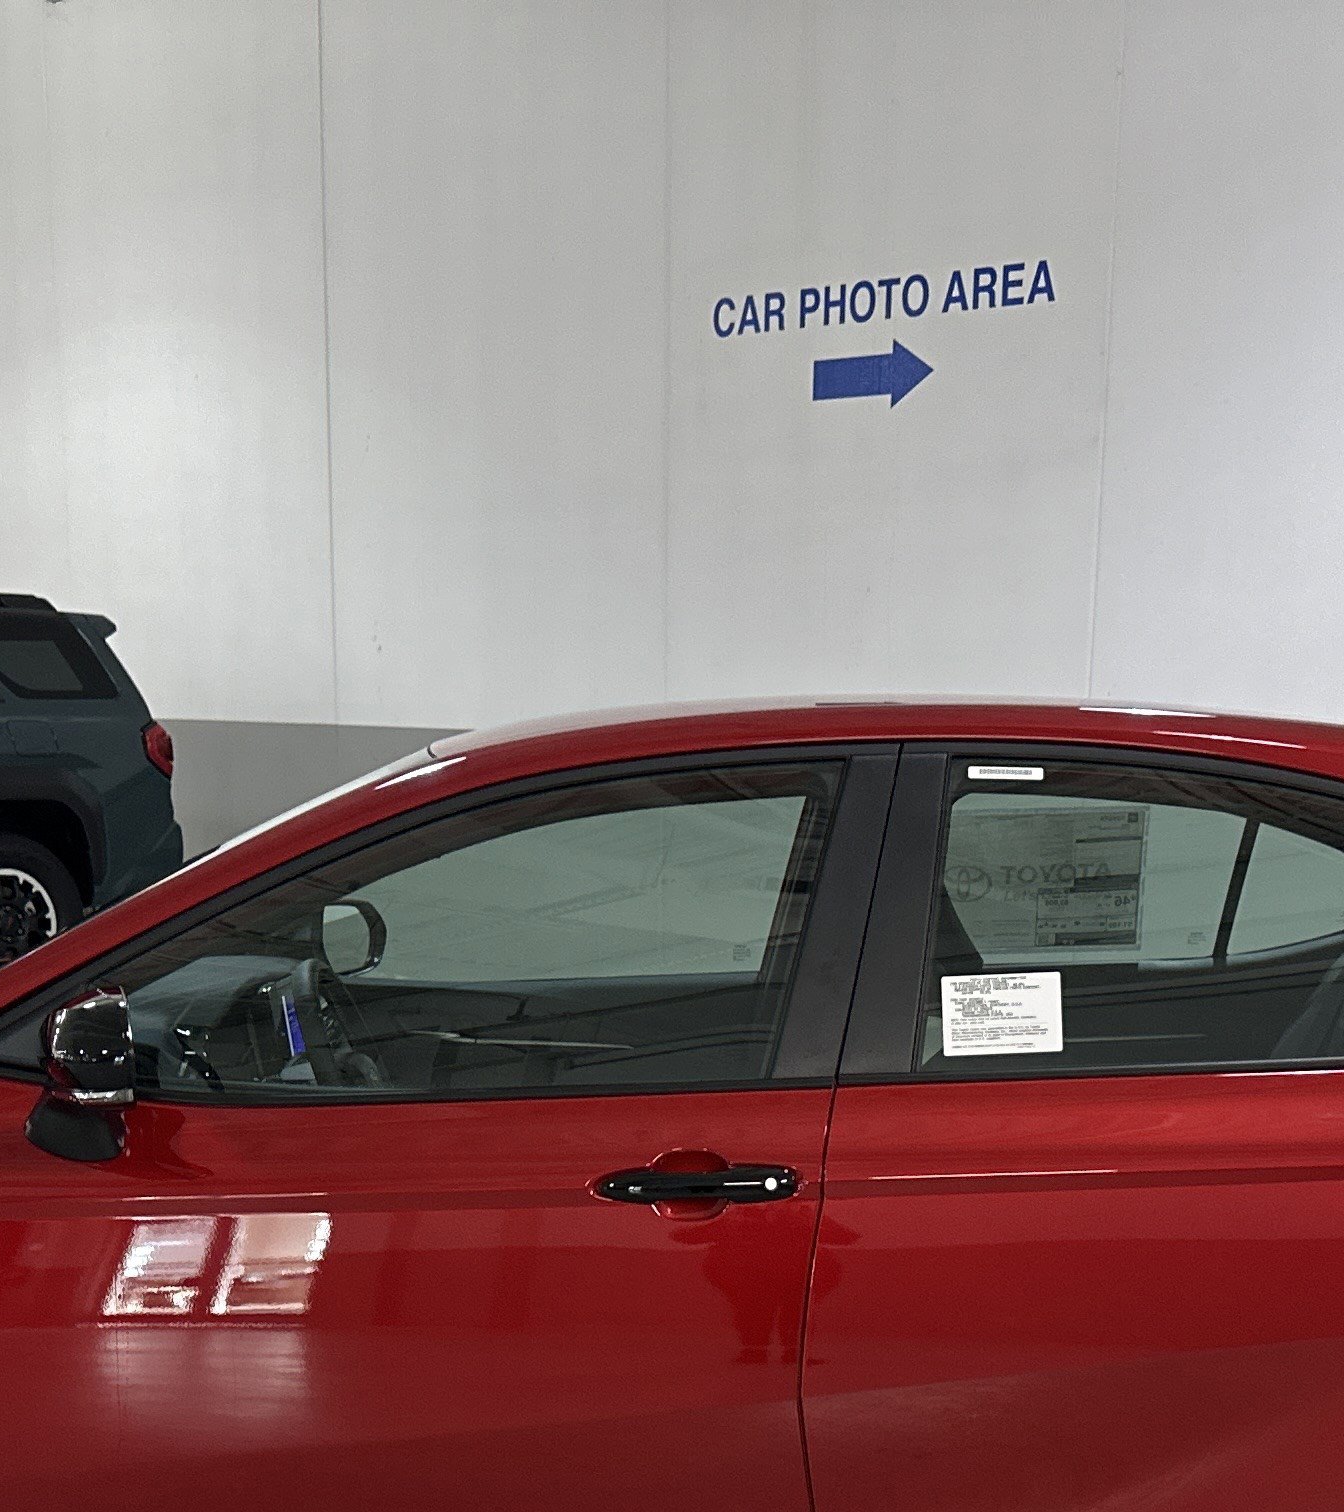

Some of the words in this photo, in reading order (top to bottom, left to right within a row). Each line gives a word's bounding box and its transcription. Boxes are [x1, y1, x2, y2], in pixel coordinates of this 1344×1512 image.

[713, 292, 786, 338] CAR
[799, 273, 930, 329] PHOTO
[942, 259, 1056, 313] AREA
[1000, 863, 1112, 885] TOYOTA
